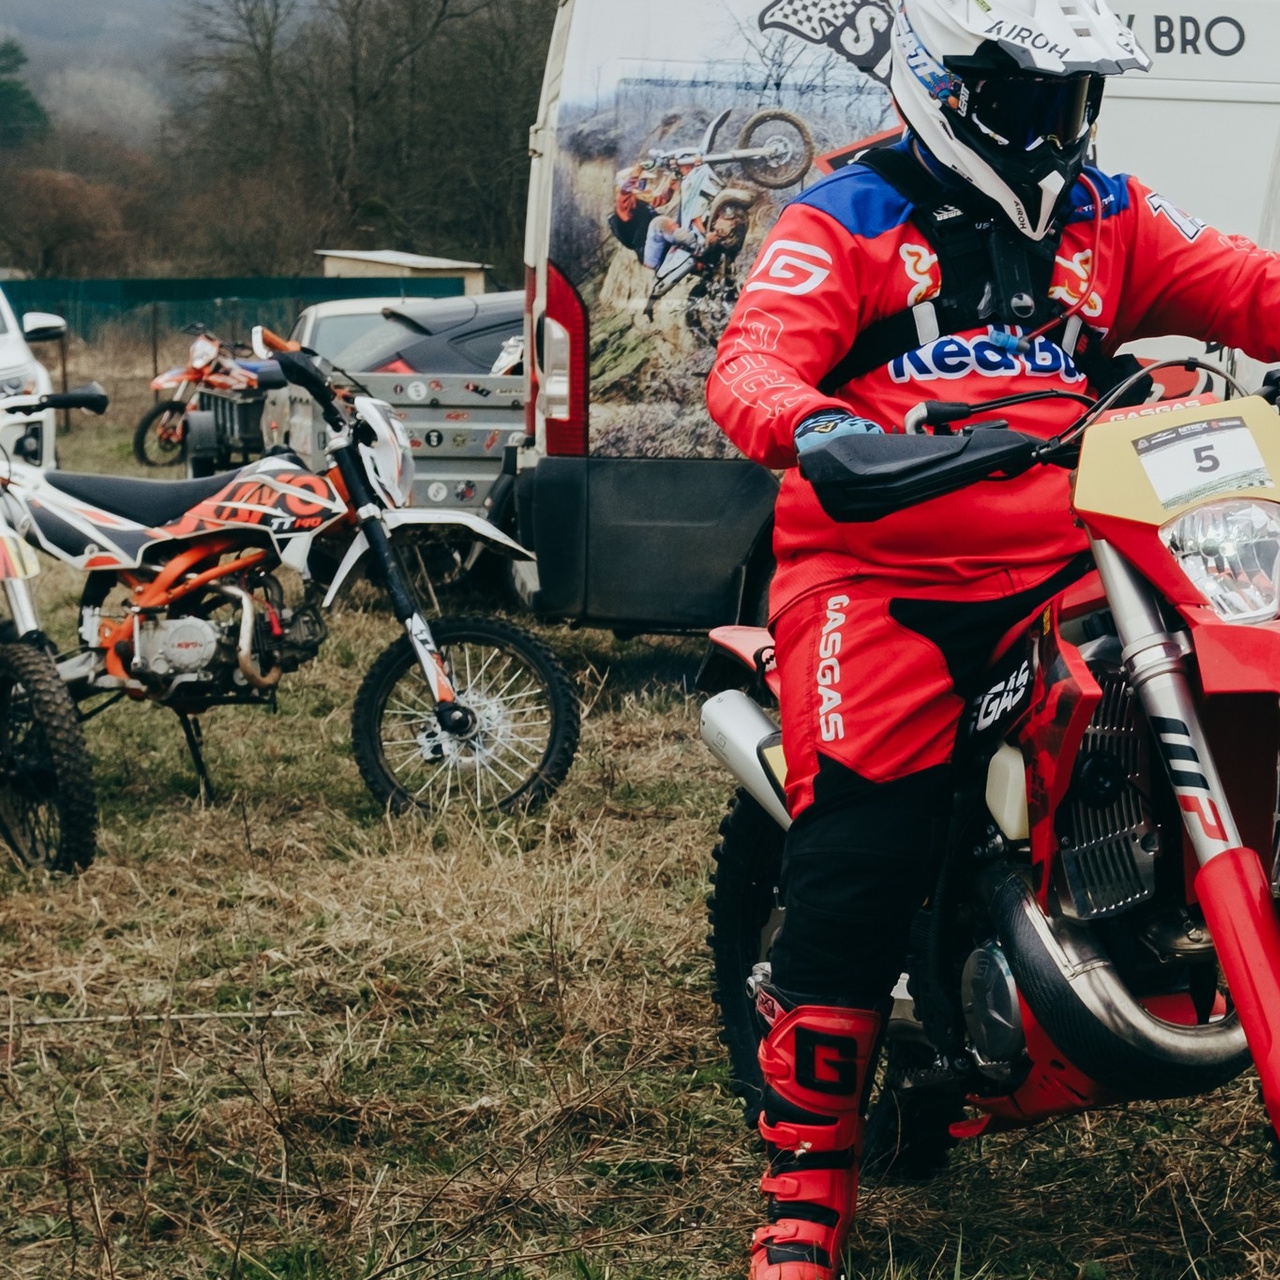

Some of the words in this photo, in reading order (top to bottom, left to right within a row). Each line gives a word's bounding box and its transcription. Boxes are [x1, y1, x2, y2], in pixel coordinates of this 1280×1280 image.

[984, 20, 1071, 60] AIROH
[1154, 14, 1246, 57] BRO
[1013, 199, 1028, 231] AIROH
[1192, 444, 1220, 474] 5
[816, 594, 851, 742] GASGAS
[795, 1026, 859, 1097] G
